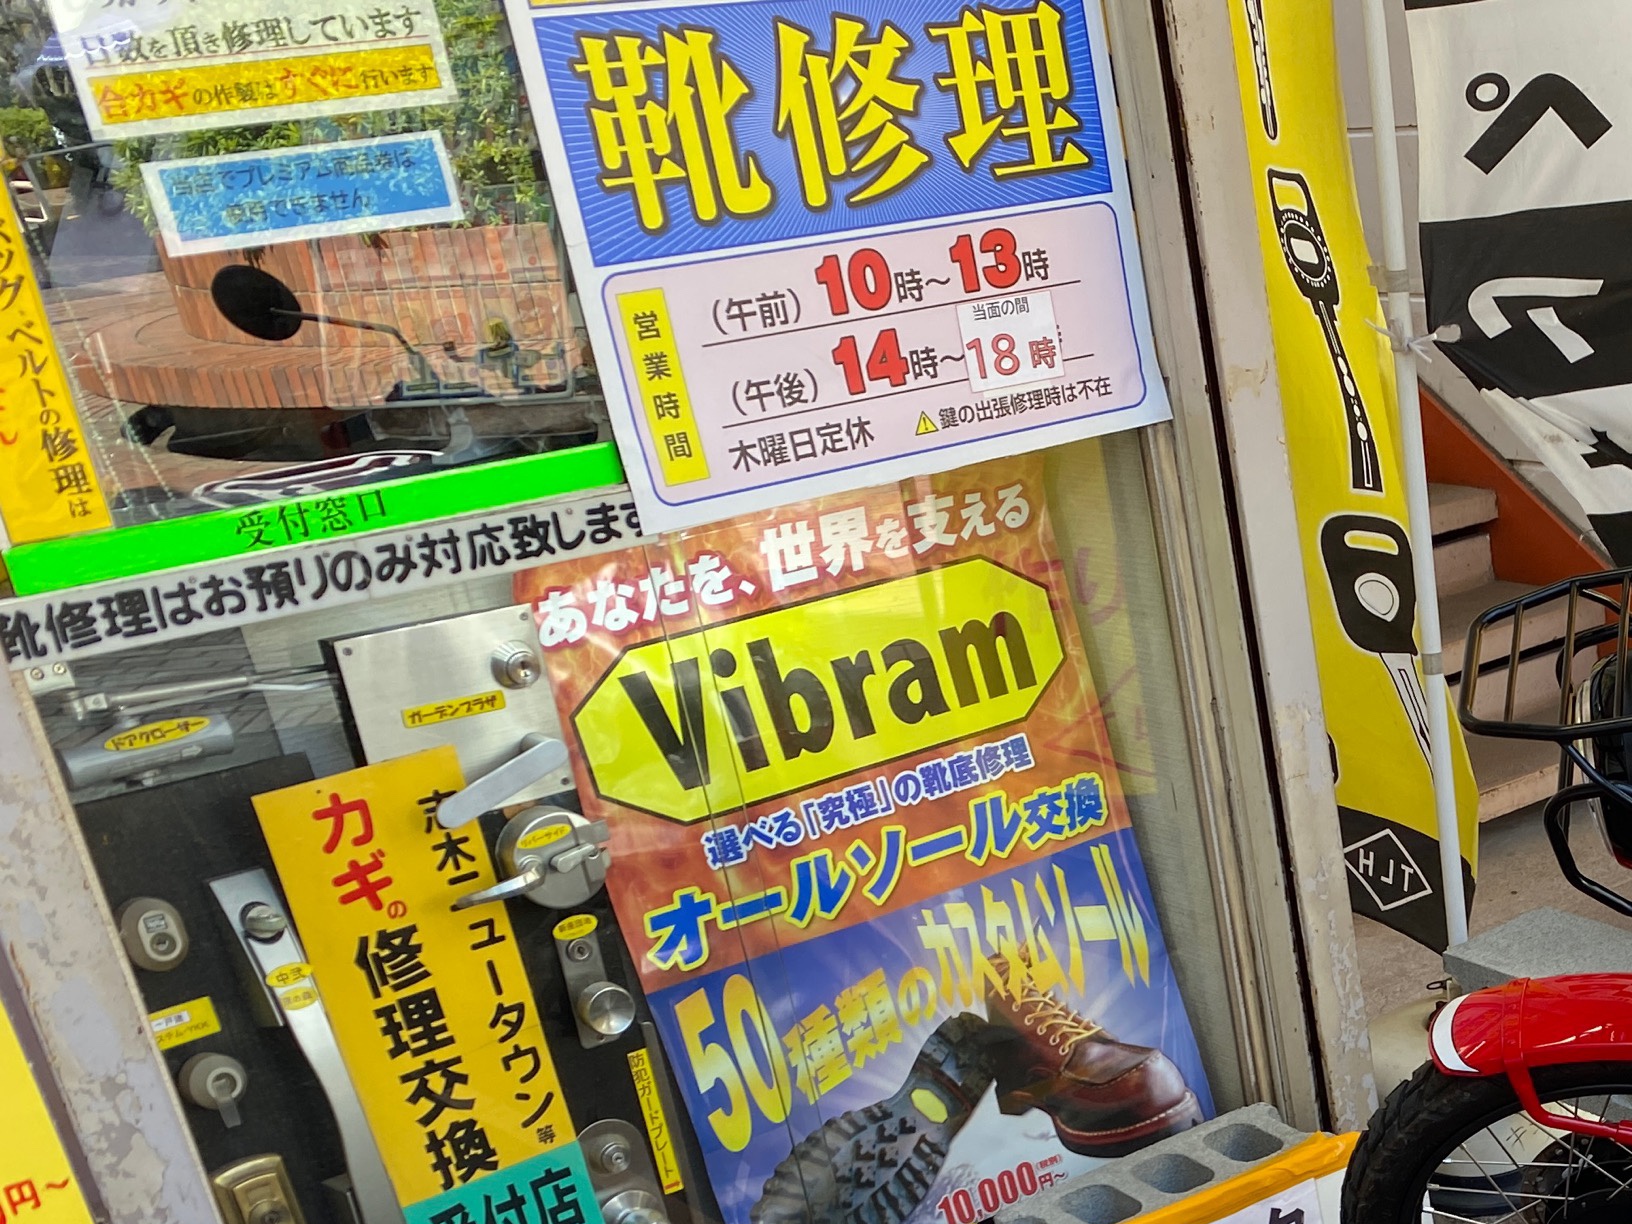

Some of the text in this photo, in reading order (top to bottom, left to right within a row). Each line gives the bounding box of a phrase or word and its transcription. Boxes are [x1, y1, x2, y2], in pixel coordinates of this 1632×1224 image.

[573, 1, 1090, 231] 靴修理
[972, 296, 1030, 321] 当面の間
[633, 310, 693, 461] 営業時間
[728, 416, 875, 474] 木曜日定休
[938, 375, 1112, 431] 鍵の出張修理時は不在
[236, 489, 387, 548] 受付窓口
[111, 720, 204, 751] ドアクローザー
[408, 694, 498, 724] ガーデンプラザ
[618, 611, 1038, 791] Vibram
[705, 737, 1031, 868] 選べる「究極」の靴底修理
[646, 774, 1107, 968] オールソール交換
[312, 793, 499, 1191] カギの修理交換
[628, 1052, 673, 1178] 防犯ガードプレート
